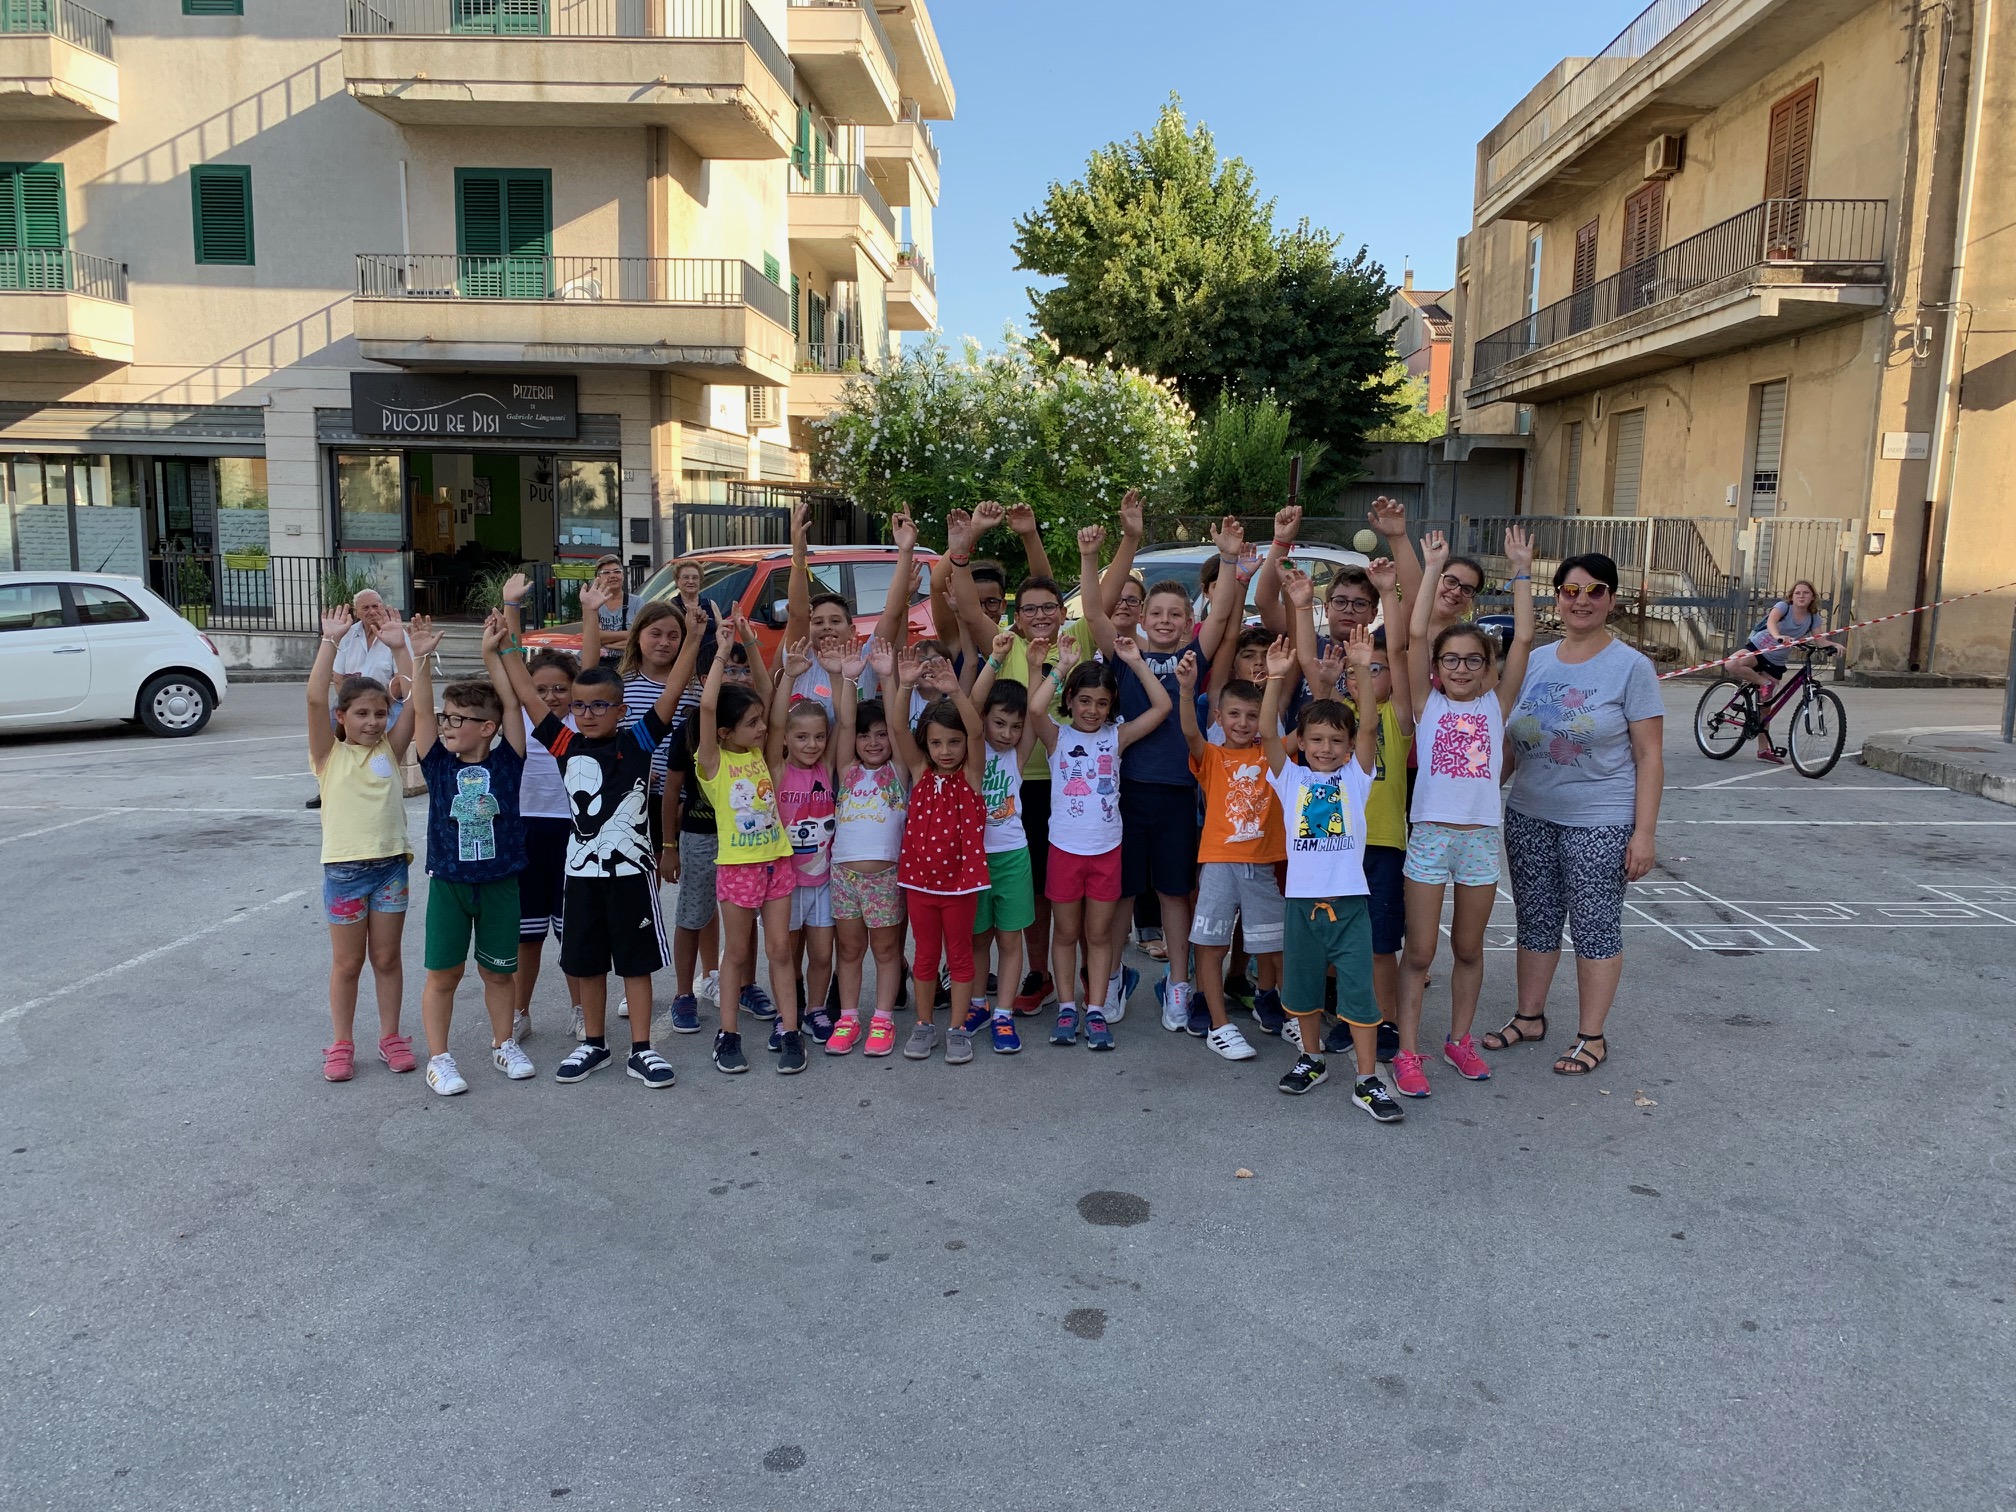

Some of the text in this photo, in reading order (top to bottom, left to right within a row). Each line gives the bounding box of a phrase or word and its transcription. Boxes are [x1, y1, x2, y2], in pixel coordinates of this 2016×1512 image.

[513, 384, 554, 400] PIZZERIA
[382, 409, 438, 432] PUOJU
[473, 411, 500, 433] DISI
[1293, 838, 1318, 852] TEAM
